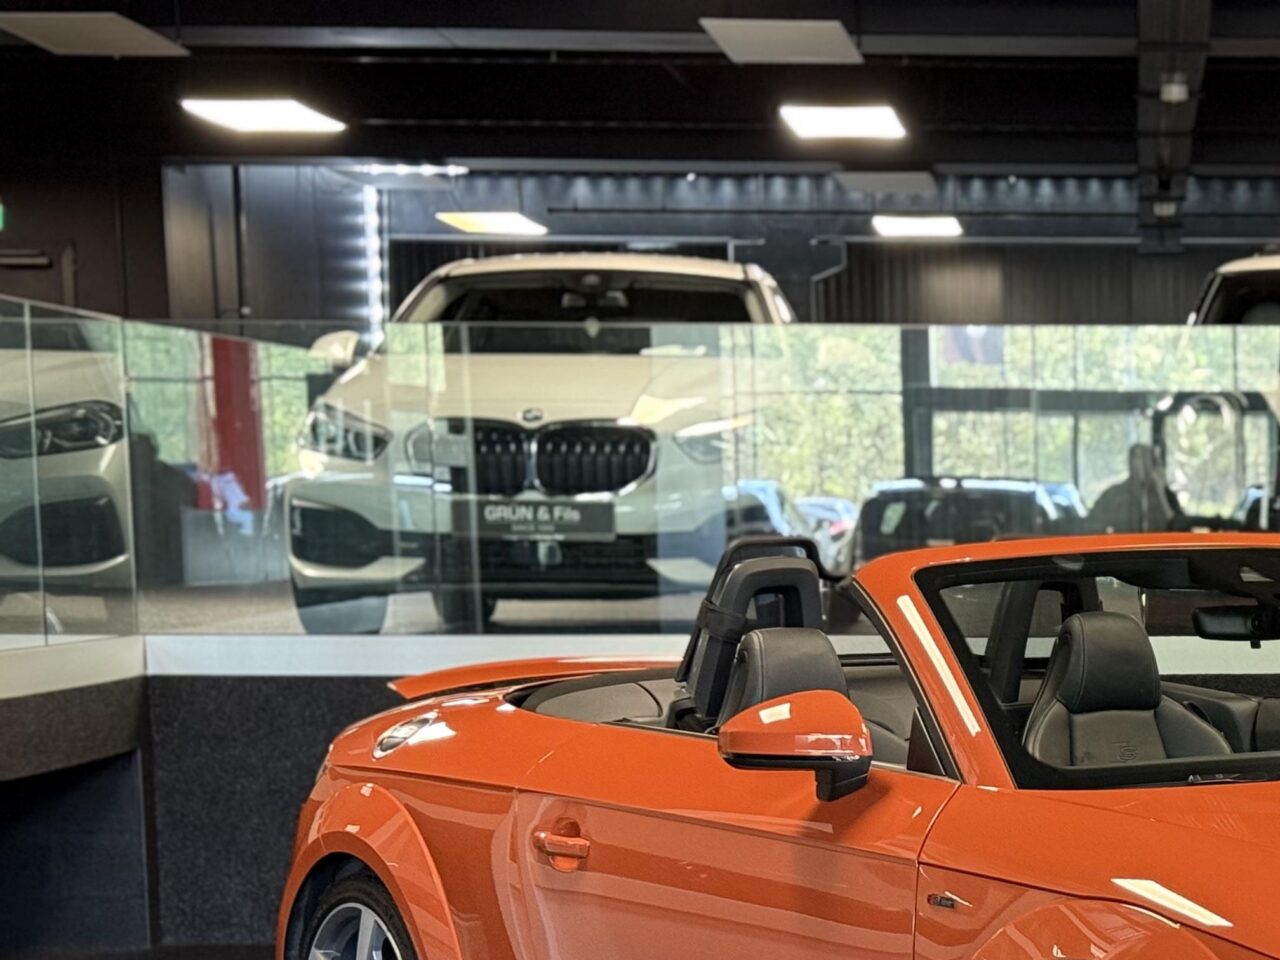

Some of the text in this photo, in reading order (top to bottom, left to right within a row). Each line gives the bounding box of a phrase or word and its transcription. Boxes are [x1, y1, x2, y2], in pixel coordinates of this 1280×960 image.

[484, 503, 581, 521] GRÜN & Fils
